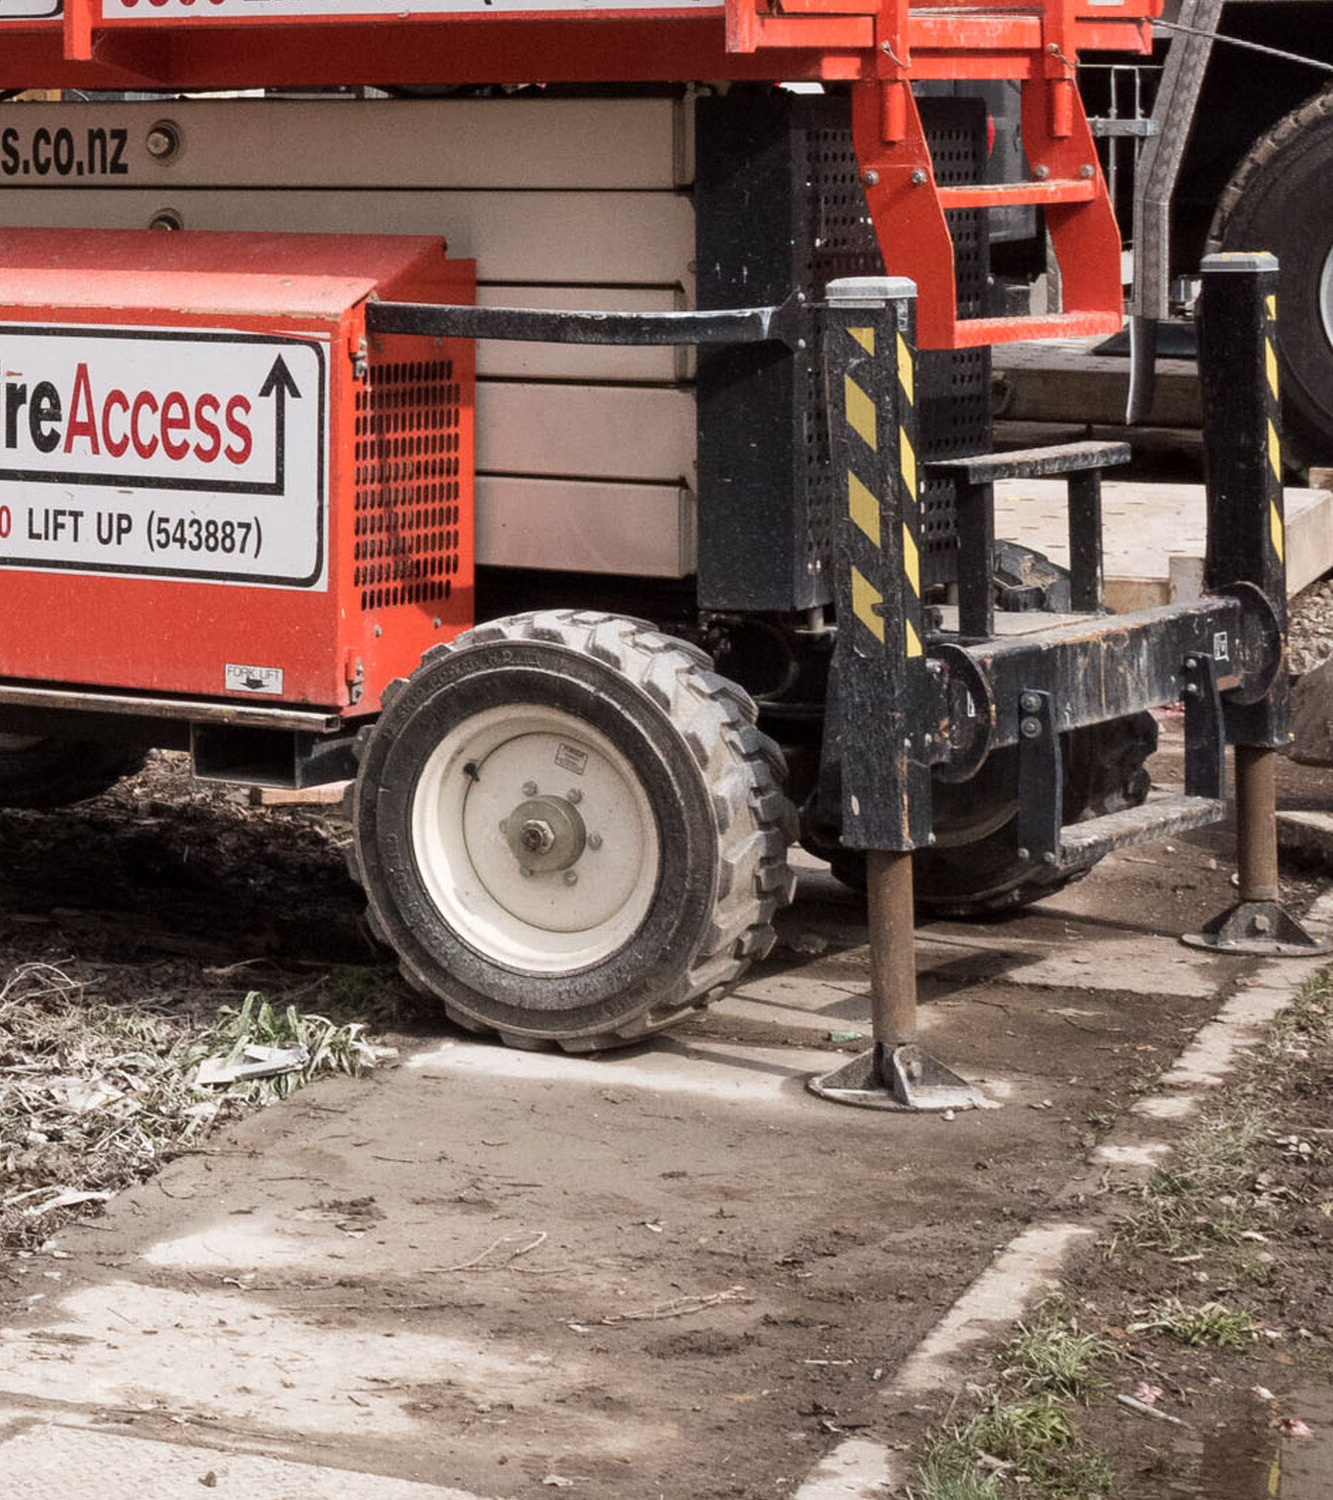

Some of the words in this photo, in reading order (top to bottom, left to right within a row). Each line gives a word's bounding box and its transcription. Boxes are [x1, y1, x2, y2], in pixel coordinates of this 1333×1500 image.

[27, 507, 84, 543] LIFT
[97, 511, 133, 546] UP
[146, 510, 263, 559] (543887)
[227, 665, 255, 677] FORK
